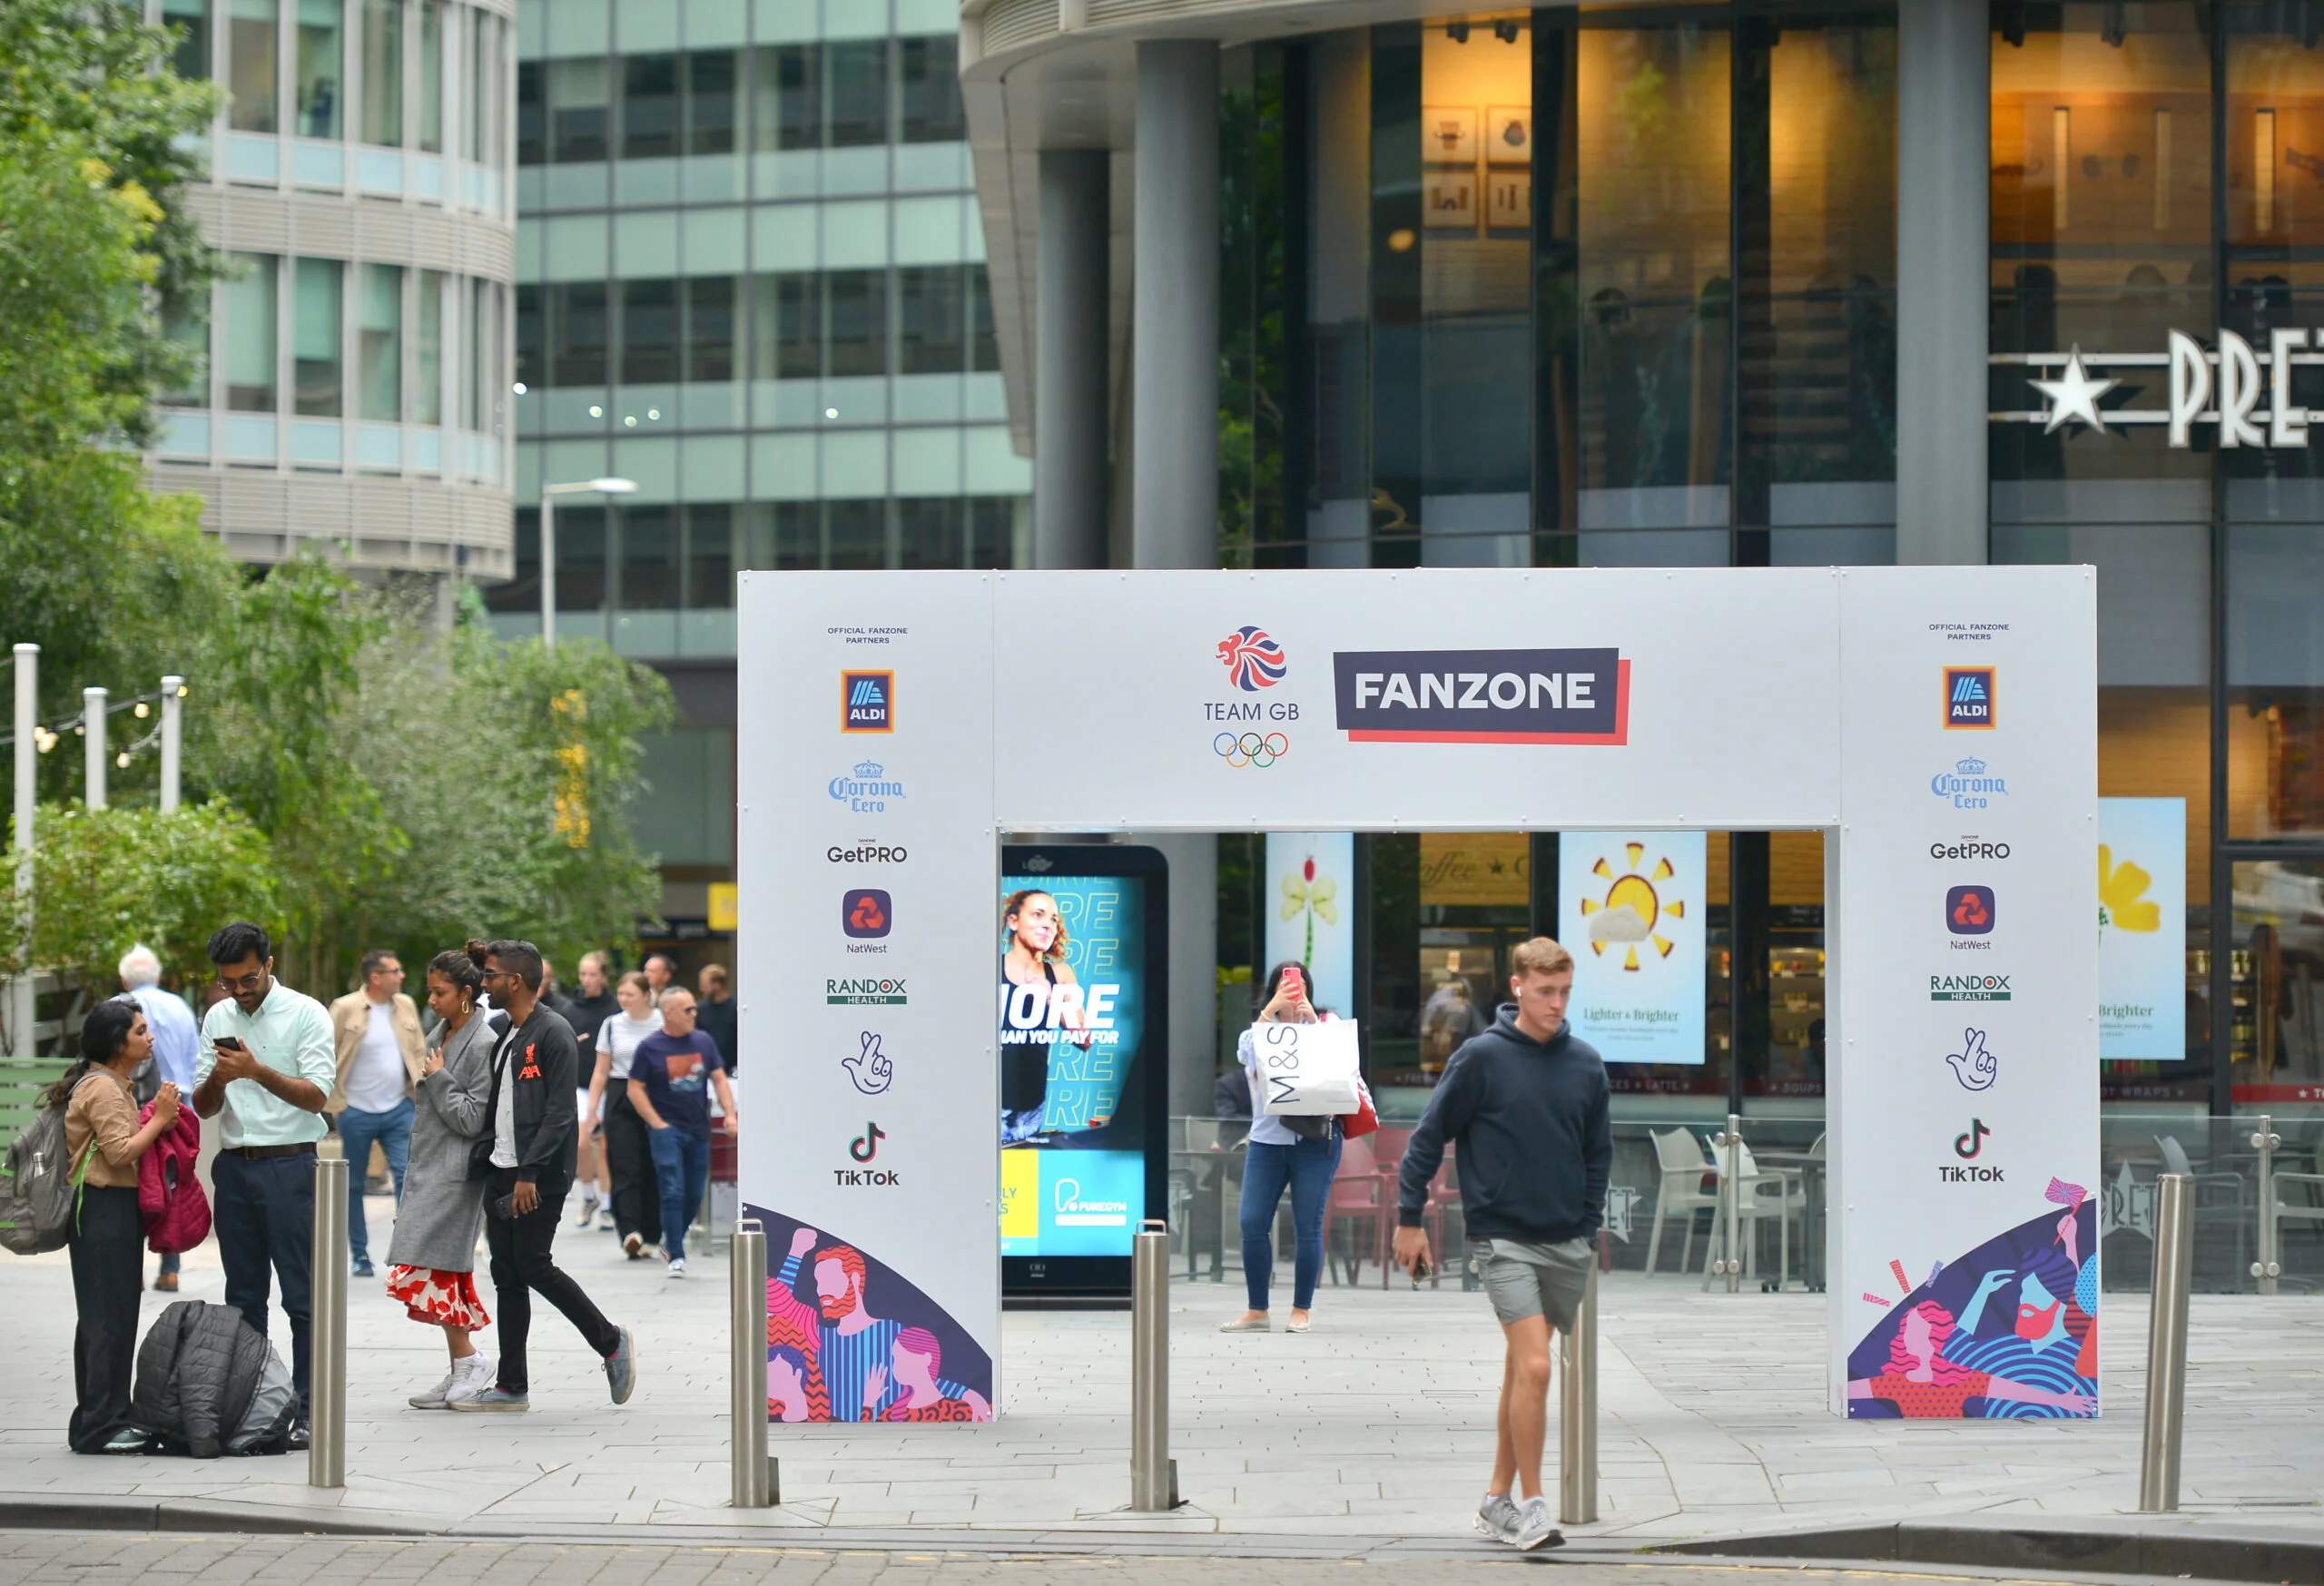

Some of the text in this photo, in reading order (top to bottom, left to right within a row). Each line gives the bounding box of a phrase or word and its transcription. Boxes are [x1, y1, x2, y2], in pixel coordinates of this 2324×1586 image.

[827, 626, 909, 635] OFFICIAL FANZONE
[1946, 633, 1992, 641] PARTNERS
[845, 636, 891, 645] PARTNERS
[1354, 672, 1596, 710] FANZONE
[850, 708, 886, 720] ALDI
[1204, 702, 1300, 721] TEAM GB
[1952, 704, 1988, 716] ALDI
[828, 777, 904, 803] Corona
[1931, 773, 2006, 799] Corona
[851, 797, 885, 813] Cero
[1955, 794, 1988, 810] Cero
[826, 846, 908, 863] GetPRO
[1930, 842, 2010, 860] GetPRO
[846, 943, 888, 953] NatWest
[1950, 940, 1992, 951] NatWest
[826, 979, 907, 994] RANDOX
[1930, 975, 2011, 990] RANDOX
[847, 995, 888, 1004] HEALTH
[1950, 991, 1992, 1001] HEALTH
[1634, 1010, 1679, 1024] Brighter
[2099, 1004, 2153, 1019] Brighter
[1029, 1030, 1059, 1044] YOU
[1060, 1030, 1090, 1044] PAY
[1090, 1030, 1119, 1044] FOR
[1267, 1026, 1301, 1104] M&S
[2122, 1087, 2171, 1098] WRAPS
[833, 1169, 901, 1187] TikTok
[1938, 1166, 2004, 1183] TikTok
